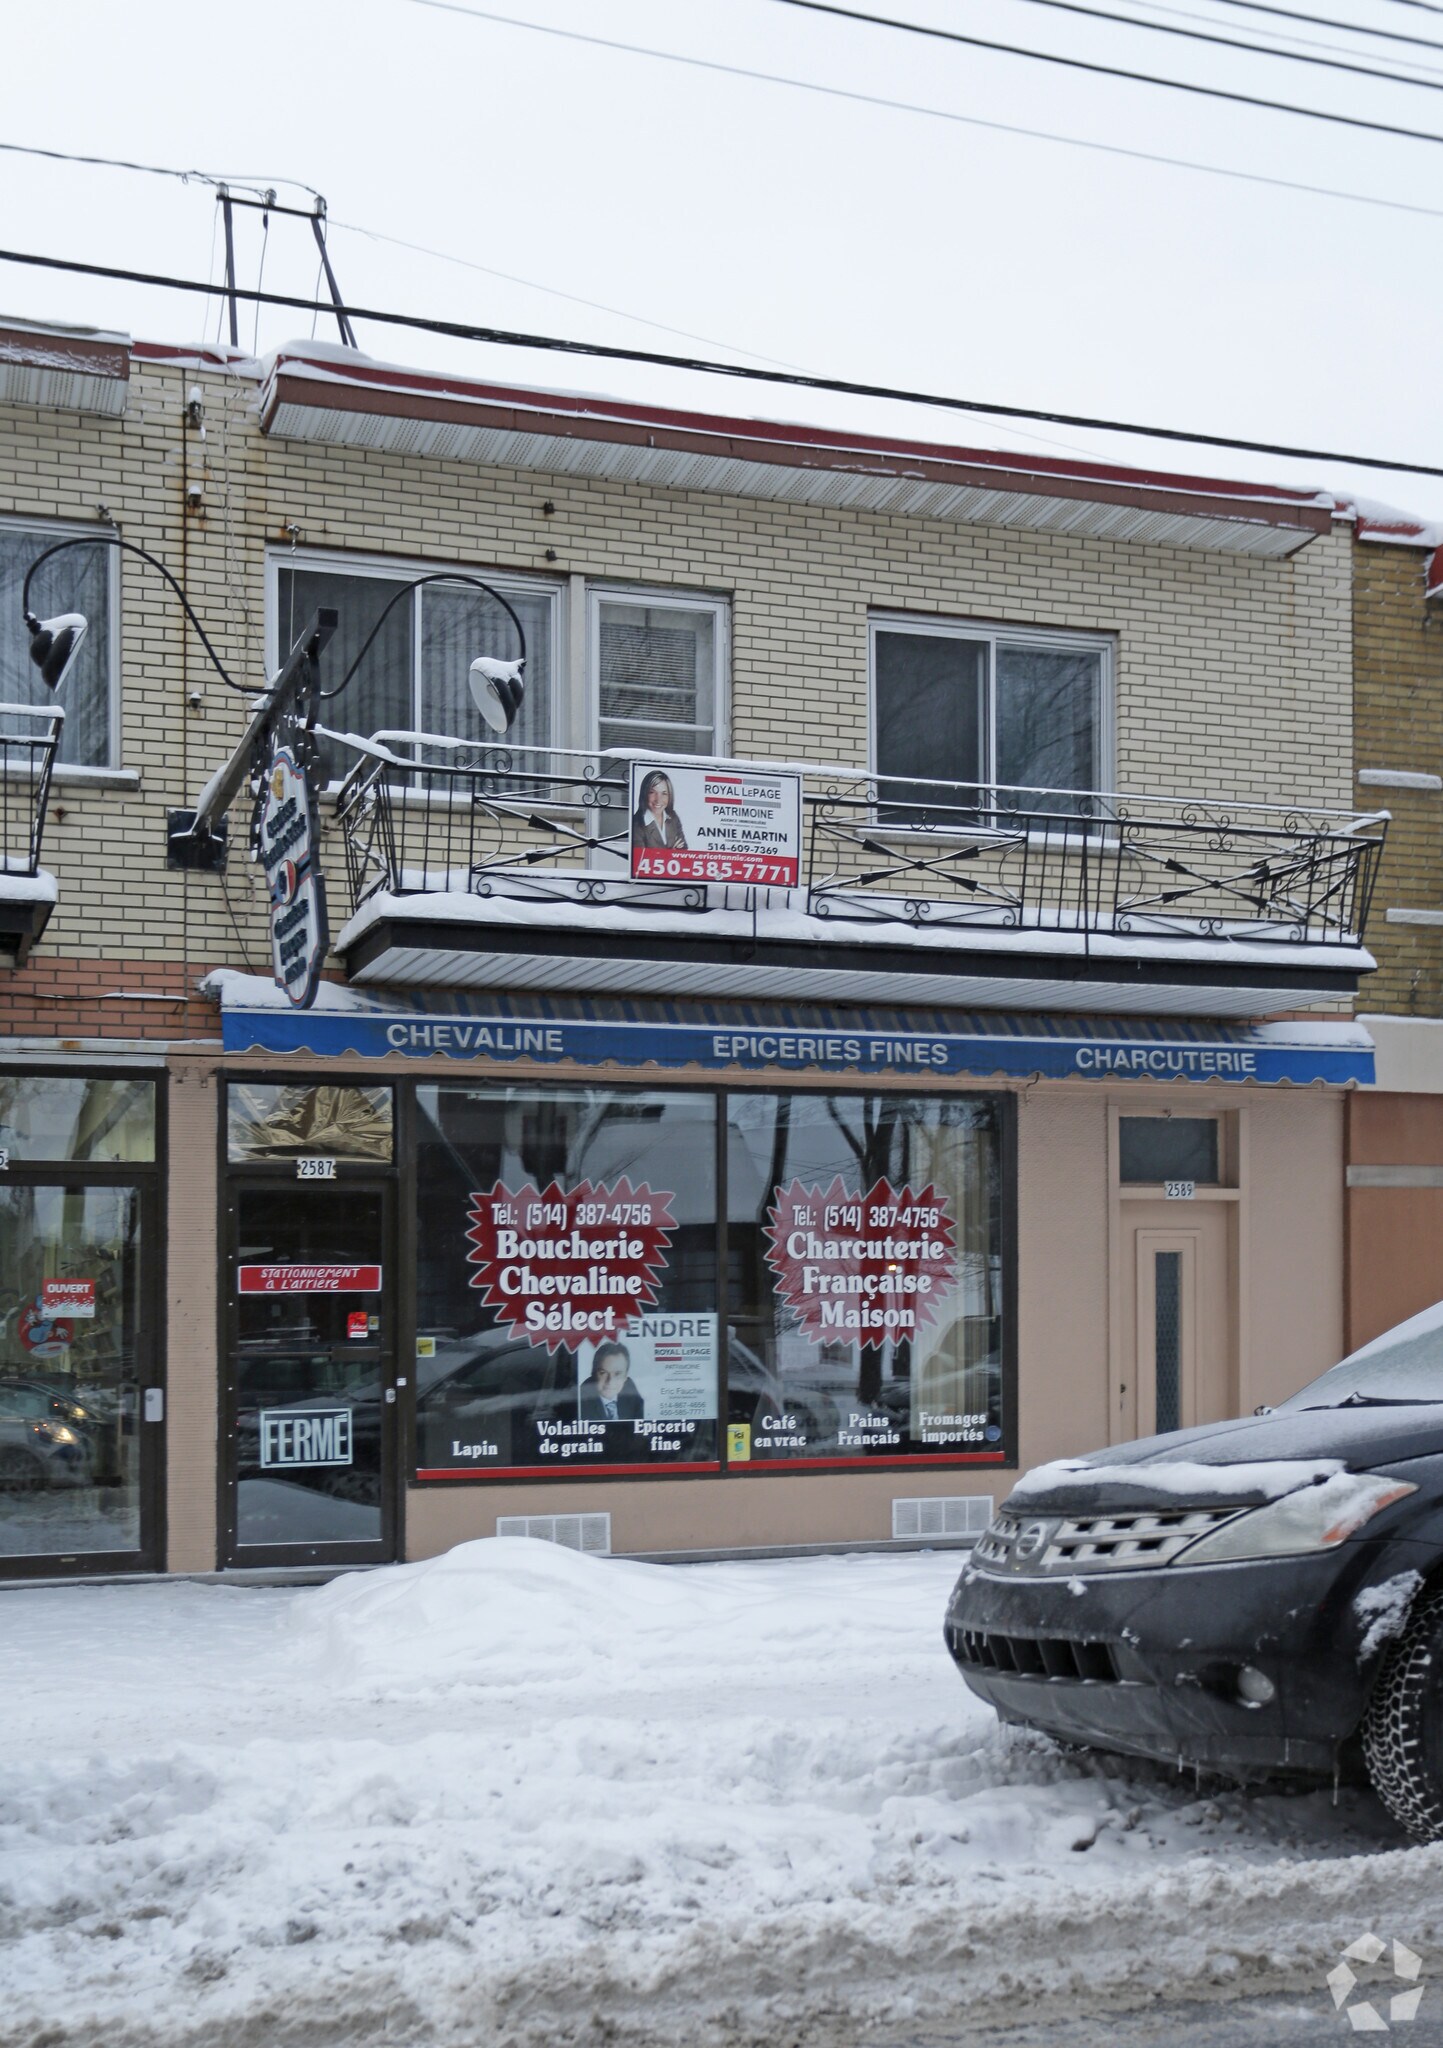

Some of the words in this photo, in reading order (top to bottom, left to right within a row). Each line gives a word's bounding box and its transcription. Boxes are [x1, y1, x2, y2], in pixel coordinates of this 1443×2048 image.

[704, 784, 740, 796] ROYAL
[712, 806, 774, 820] PATRIMOINE
[697, 827, 737, 839] ANNIE
[741, 830, 788, 843] MARTIN
[707, 843, 779, 855] 514-609-7369
[637, 858, 791, 883] 450-585-7771
[386, 1024, 564, 1052] CHEVALINE
[712, 1036, 861, 1062] EPICERIES
[869, 1040, 949, 1065] FINES
[1075, 1048, 1257, 1073] CHARCUTERIE
[301, 1160, 333, 1176] 2587
[1167, 1183, 1193, 1197] 2589
[526, 1203, 567, 1231] (514)
[575, 1204, 652, 1226] 387-4756
[824, 1206, 861, 1232] (514)
[869, 1206, 939, 1228] 387-4756
[496, 1230, 644, 1259] Boucherie
[786, 1231, 945, 1260] Charcuterie
[47, 1283, 91, 1294] OUVERT
[499, 1265, 642, 1295] Chevaline
[802, 1266, 932, 1300] Française
[525, 1301, 616, 1331] Sélect
[819, 1300, 916, 1328] Maison
[654, 1348, 680, 1356] ROYAL
[537, 1420, 606, 1436] Volailles
[761, 1415, 797, 1430] Café
[848, 1413, 889, 1428] Pains
[918, 1411, 987, 1428] Fromages
[264, 1412, 348, 1463] FERMÉ
[650, 1435, 682, 1451] fine
[754, 1436, 772, 1448] en
[774, 1434, 807, 1447] vrac
[838, 1430, 900, 1447] Français
[921, 1428, 985, 1444] importés
[452, 1440, 498, 1458] Lapin
[539, 1438, 558, 1454] de
[561, 1438, 604, 1457] grain
